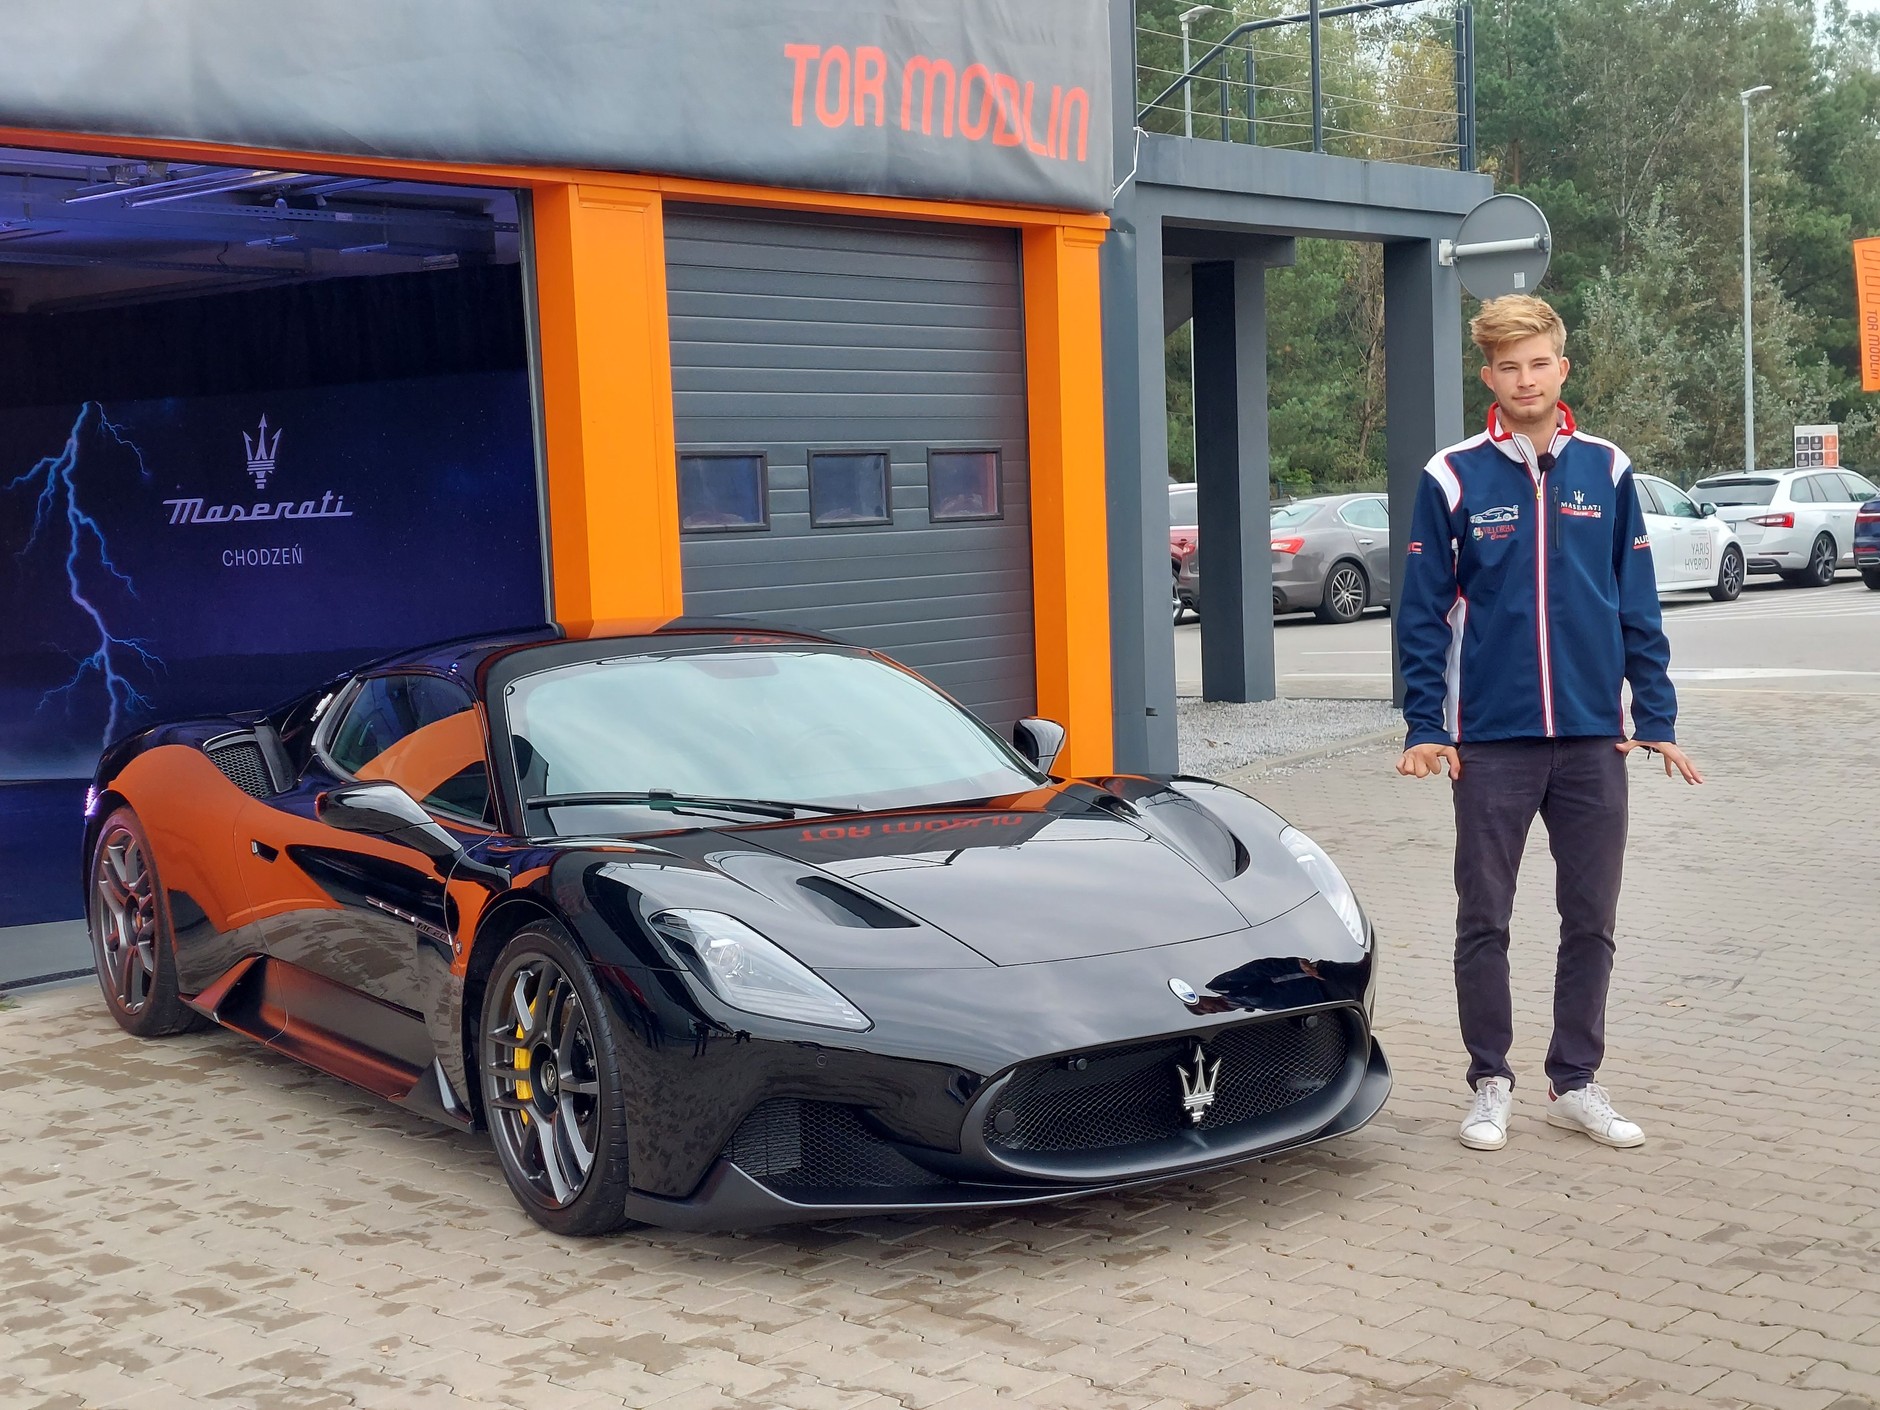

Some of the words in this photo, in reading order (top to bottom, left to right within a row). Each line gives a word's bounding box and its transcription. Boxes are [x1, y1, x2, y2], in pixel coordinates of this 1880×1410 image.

[784, 43, 887, 128] TOR
[1866, 309, 1878, 331] TOR
[163, 490, 353, 525] Maserati
[1560, 501, 1602, 512] MASERATI
[222, 543, 304, 567] CHODZEŃ
[1691, 542, 1710, 555] YARIS
[1684, 557, 1710, 570] HYBRID
